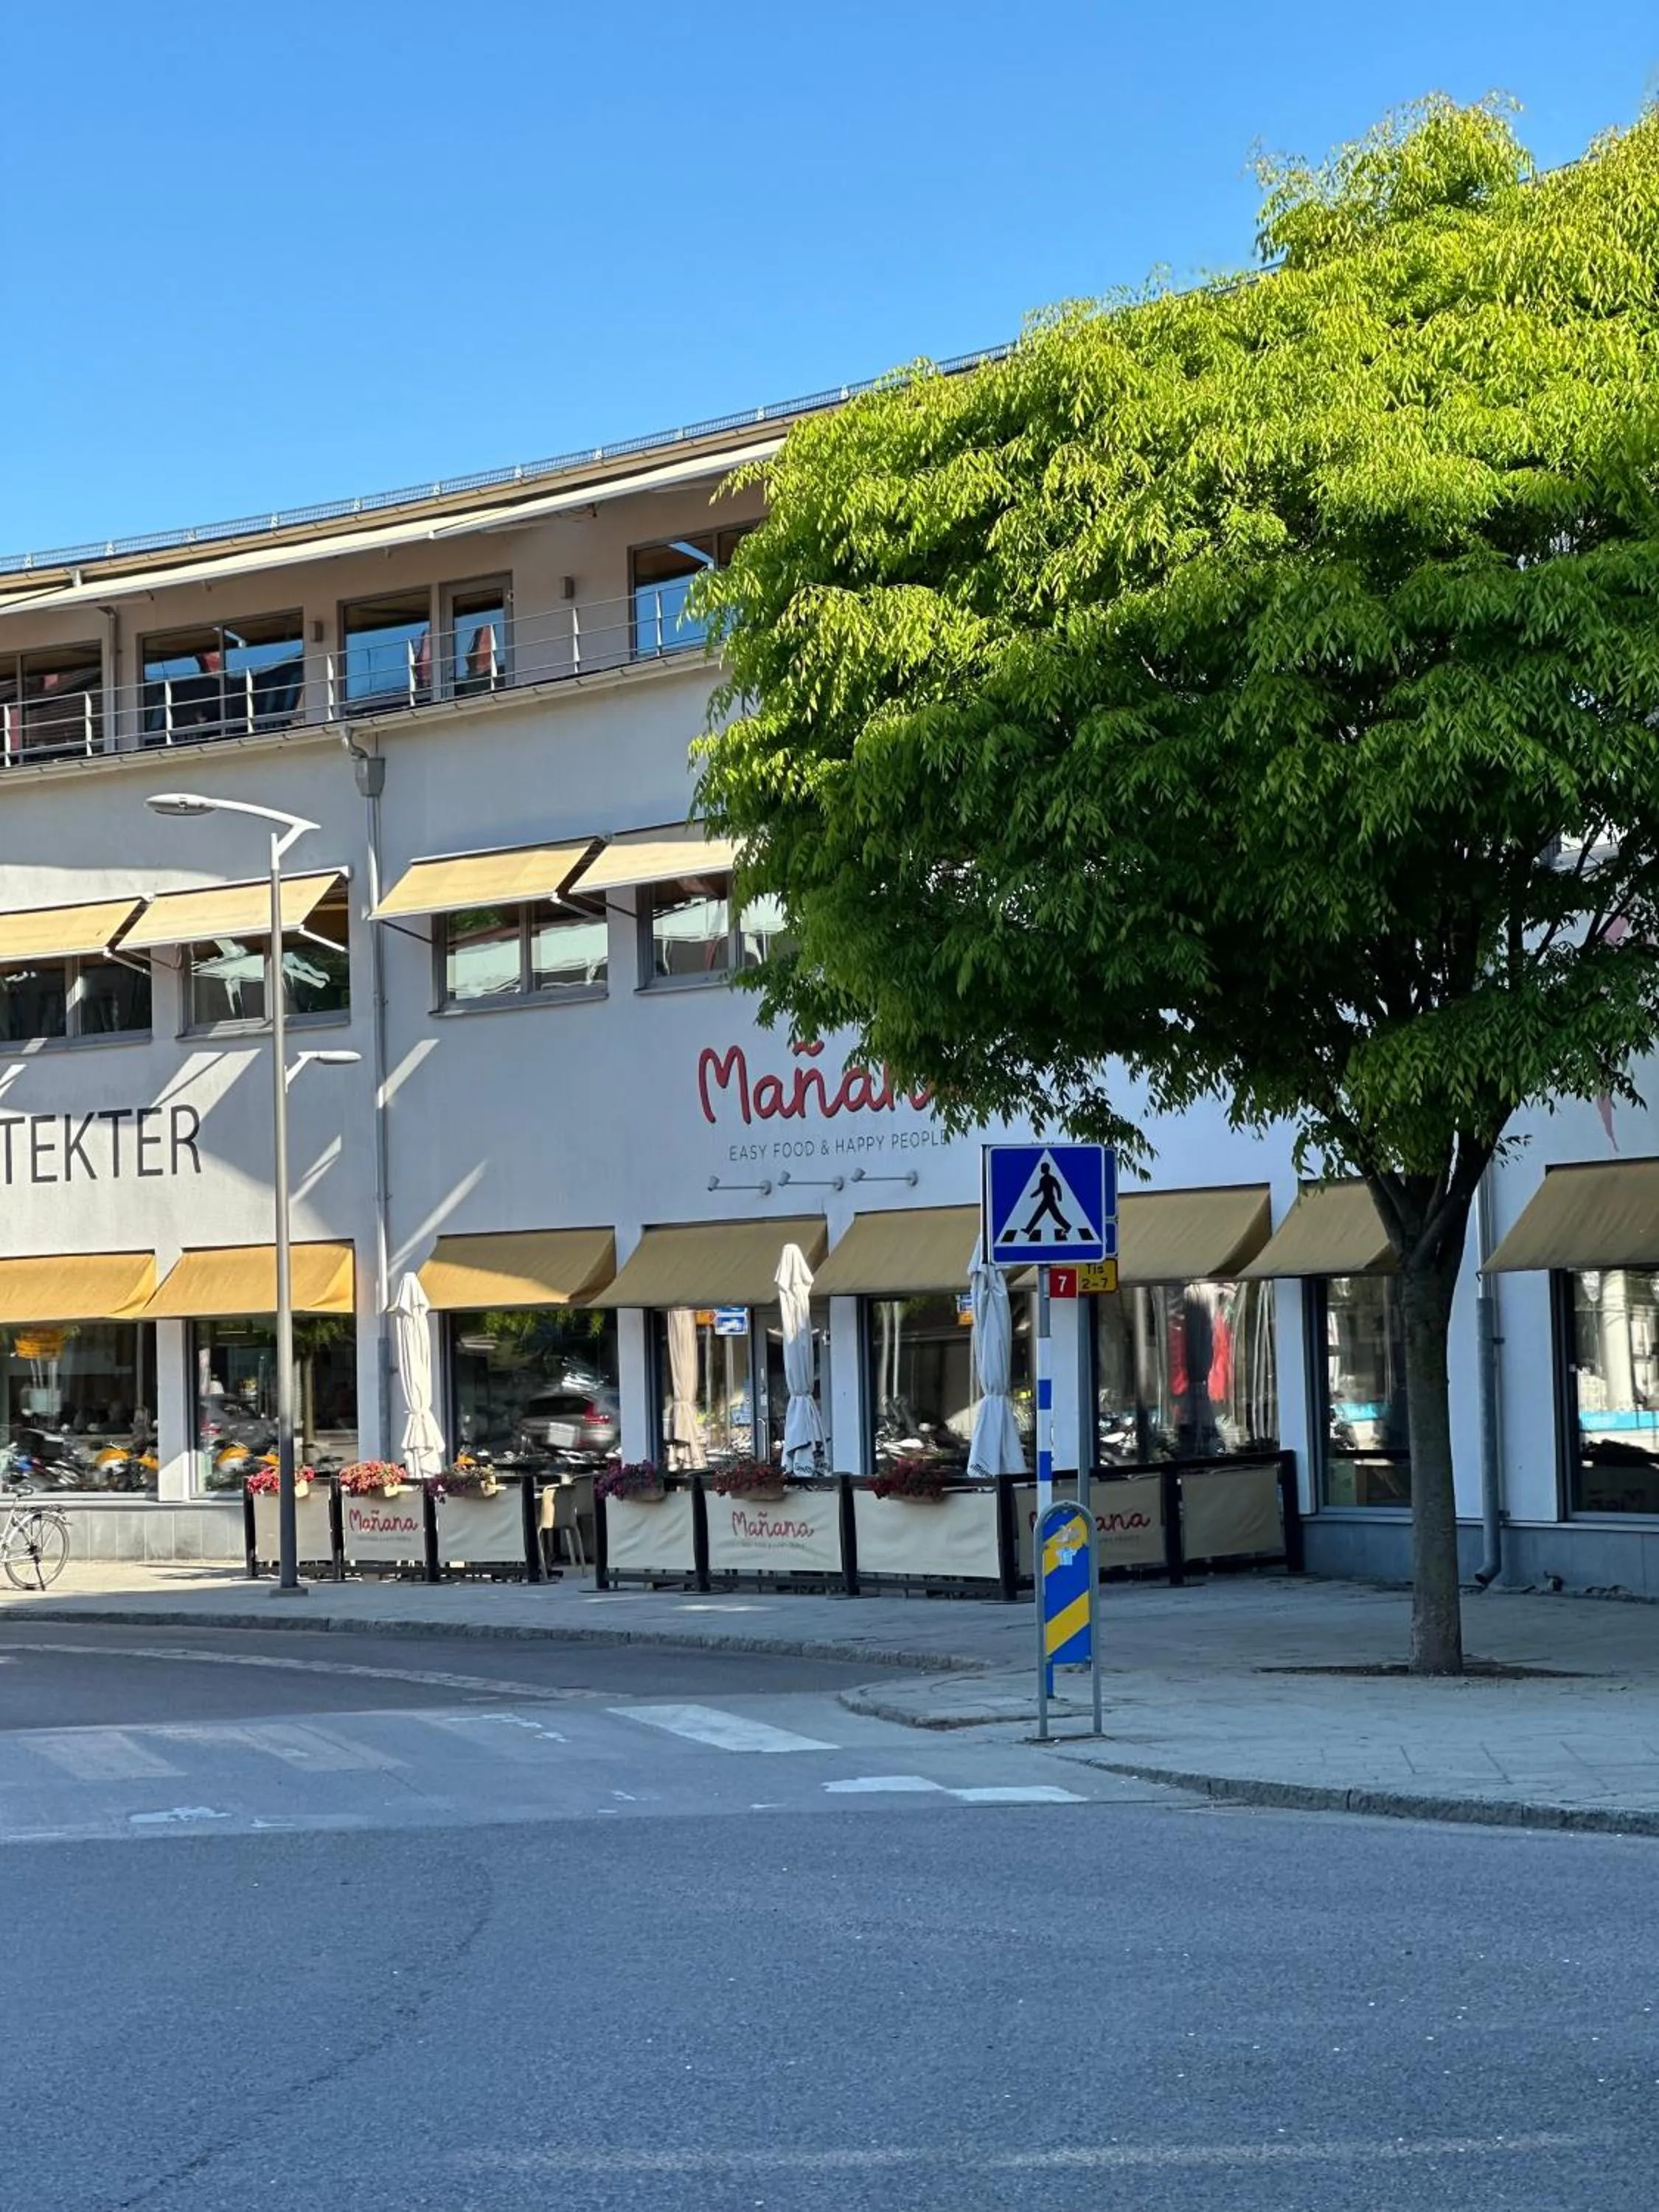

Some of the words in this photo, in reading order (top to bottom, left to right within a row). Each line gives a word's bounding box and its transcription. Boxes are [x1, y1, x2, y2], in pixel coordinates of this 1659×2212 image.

[0, 1104, 201, 1185] TEKTER
[729, 1144, 767, 1162] EASY
[773, 1141, 815, 1158] FOOD
[821, 1139, 830, 1156] &
[835, 1135, 885, 1155] HAPPY
[1057, 1275, 1068, 1293] 7
[349, 1508, 419, 1531] Mañana
[732, 1510, 814, 1537] Mañana
